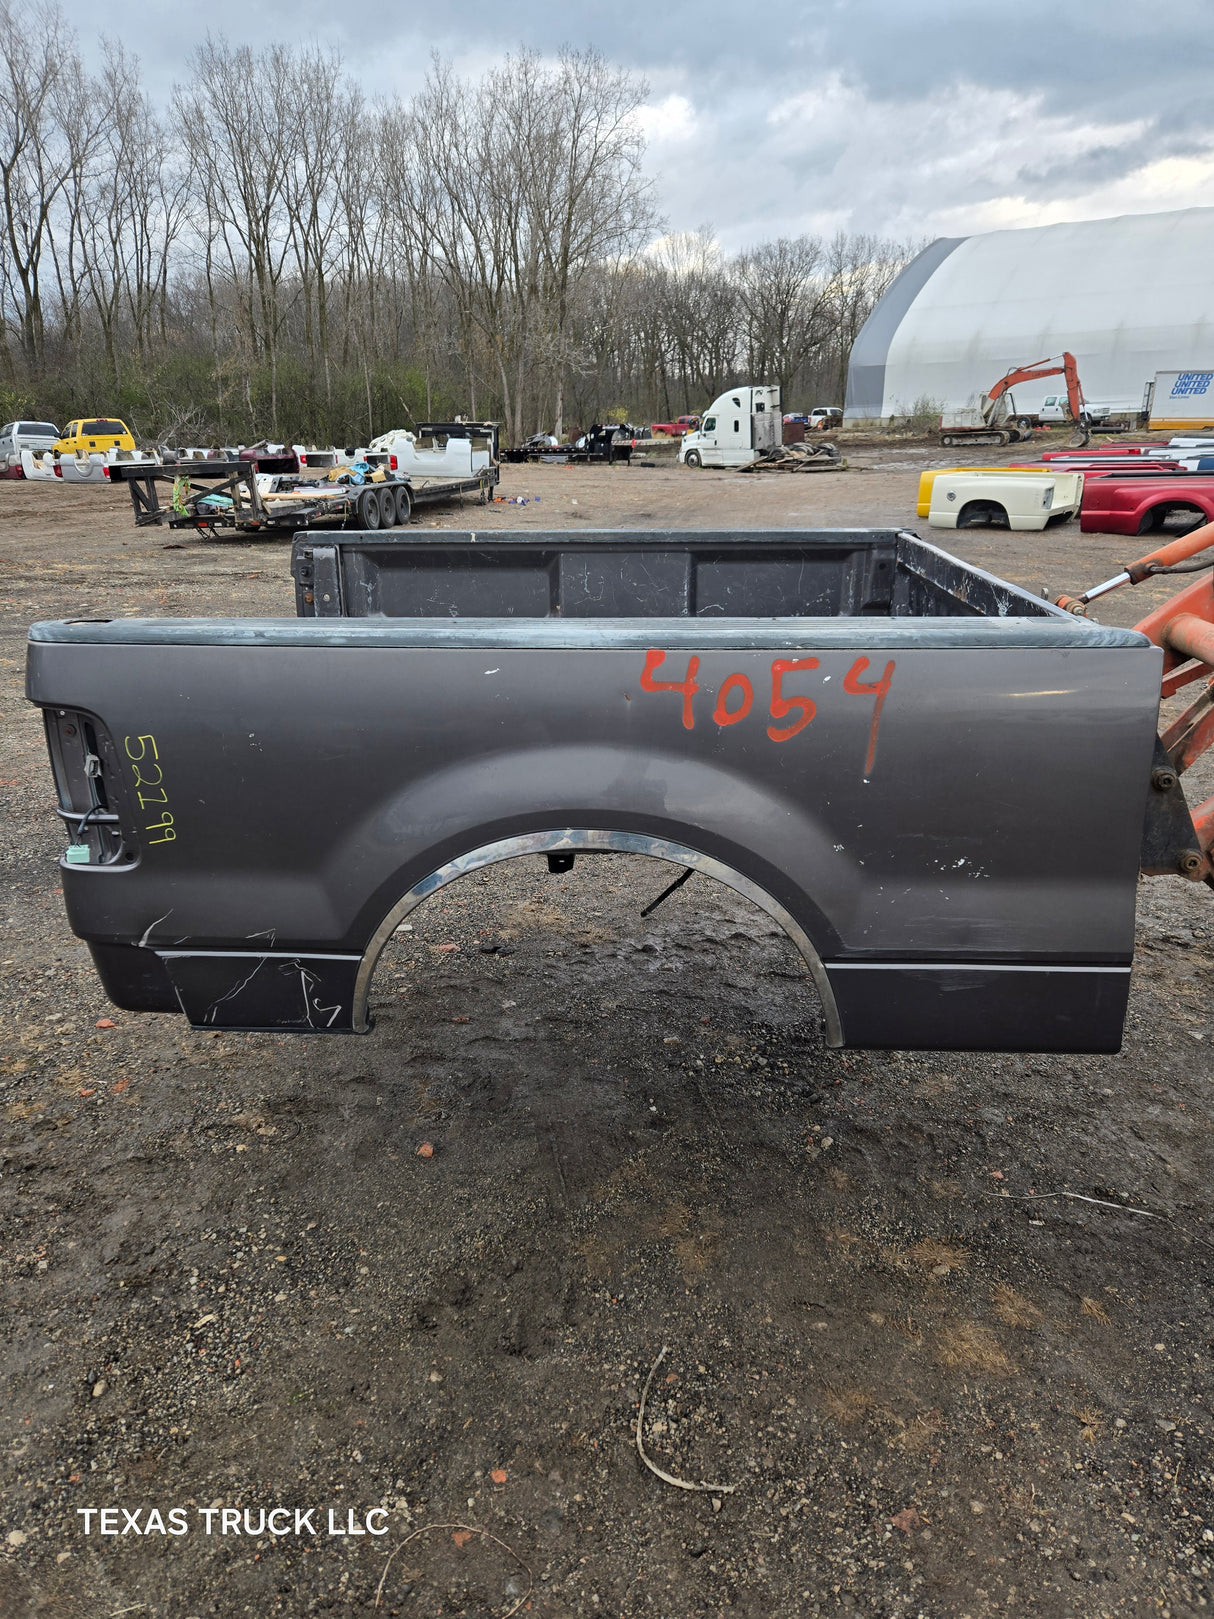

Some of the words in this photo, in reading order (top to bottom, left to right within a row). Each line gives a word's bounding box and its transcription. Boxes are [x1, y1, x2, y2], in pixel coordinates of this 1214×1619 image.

[1178, 373, 1213, 381] UNITED
[1175, 380, 1210, 388] UNITED
[1171, 387, 1206, 395] UNITED
[640, 649, 896, 775] 4054
[124, 734, 177, 844] 52199
